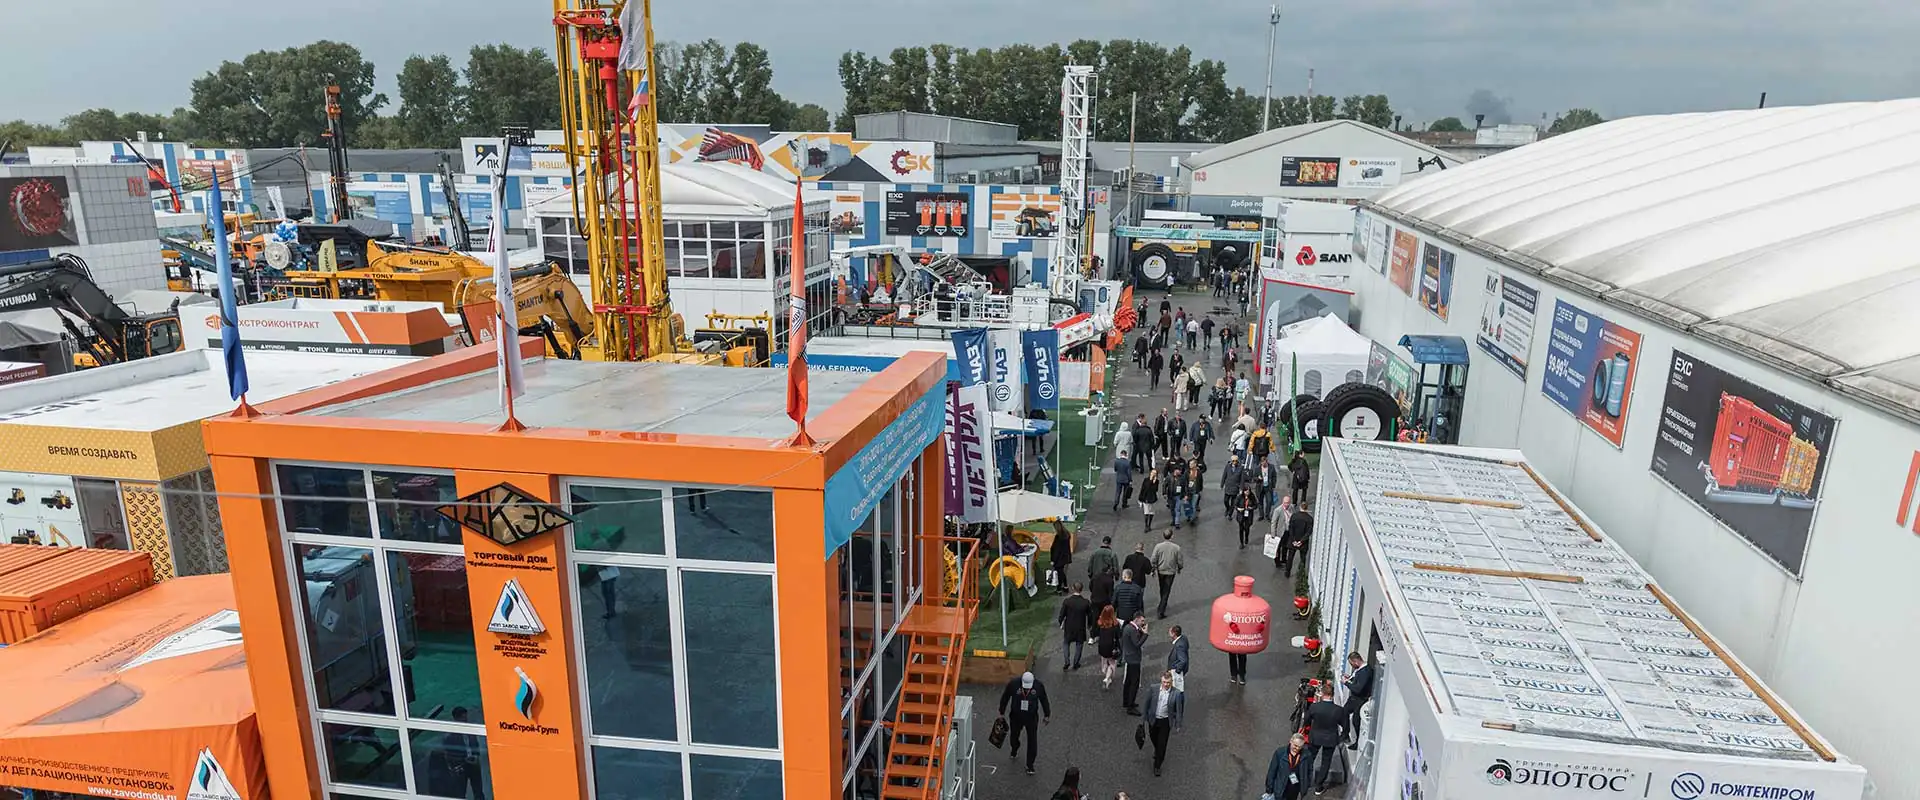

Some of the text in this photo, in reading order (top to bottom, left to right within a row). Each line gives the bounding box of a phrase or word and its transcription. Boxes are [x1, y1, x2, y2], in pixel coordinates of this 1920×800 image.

[487, 159, 499, 169] ПК
[409, 259, 440, 267] SHANTUI
[517, 294, 543, 311] SHANTUI
[239, 319, 320, 329] ХСТРОЙКОНТРАКТ
[995, 348, 1008, 383] ЧАЗ
[1035, 347, 1049, 382] ЧАЗ
[1674, 357, 1693, 377] EXC
[48, 445, 138, 460] ВРЕМЯ СОЗДАВАТЬ
[959, 402, 987, 509] ЧЕТРА
[474, 551, 548, 564] ТОРГОВЫЙ ДОМ
[499, 721, 560, 735] ЮжСтрой-Групп
[112, 767, 170, 780] ПРЕДПРИЯТИЕ
[1515, 759, 1630, 774] группа компаний
[11, 766, 105, 785] ДЕГАЗАЦИОННЫХ
[106, 777, 175, 791] УСТАНОВОК»
[1513, 766, 1627, 792] ЭПОТОС
[87, 784, 178, 800] www.zavodmdu.ru
[1709, 782, 1816, 800] ПОЖТЕХПРОМ
